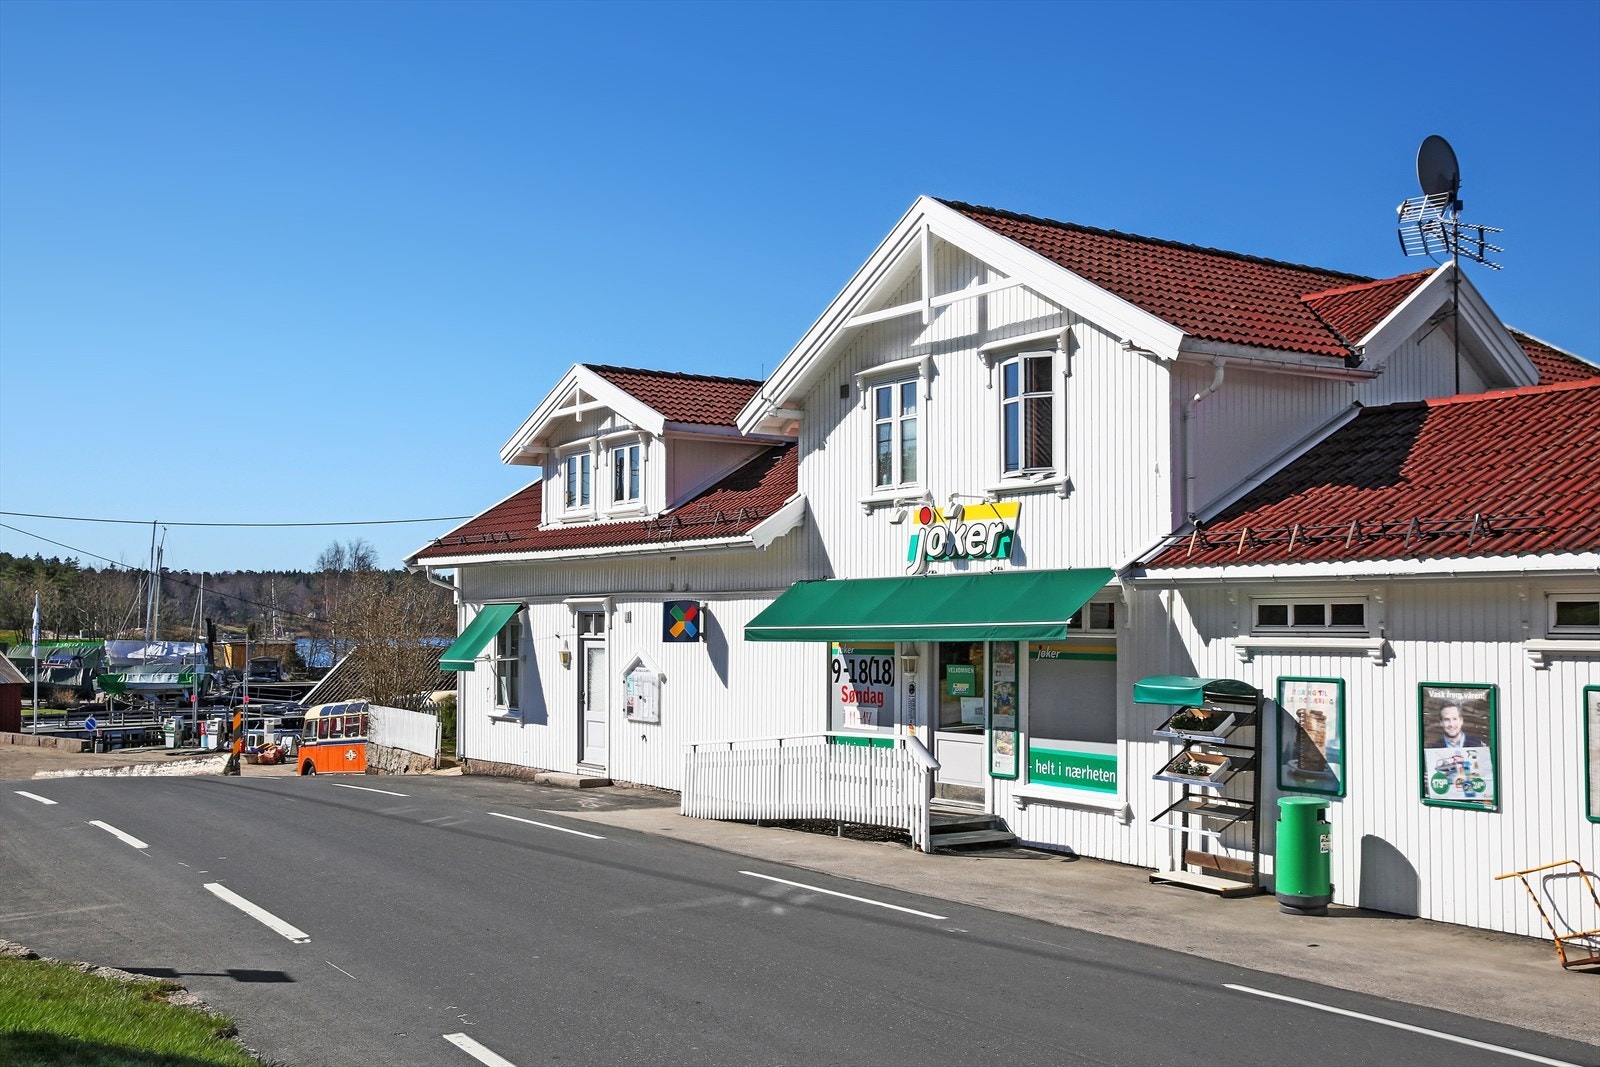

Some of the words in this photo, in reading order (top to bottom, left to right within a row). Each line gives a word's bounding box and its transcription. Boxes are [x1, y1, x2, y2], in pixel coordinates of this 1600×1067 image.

[906, 507, 1006, 576] joker
[1036, 645, 1061, 662] joker
[841, 685, 884, 708] Søndag
[1035, 759, 1055, 776] helt
[1058, 762, 1062, 776] i
[1065, 766, 1116, 783] nærheten
